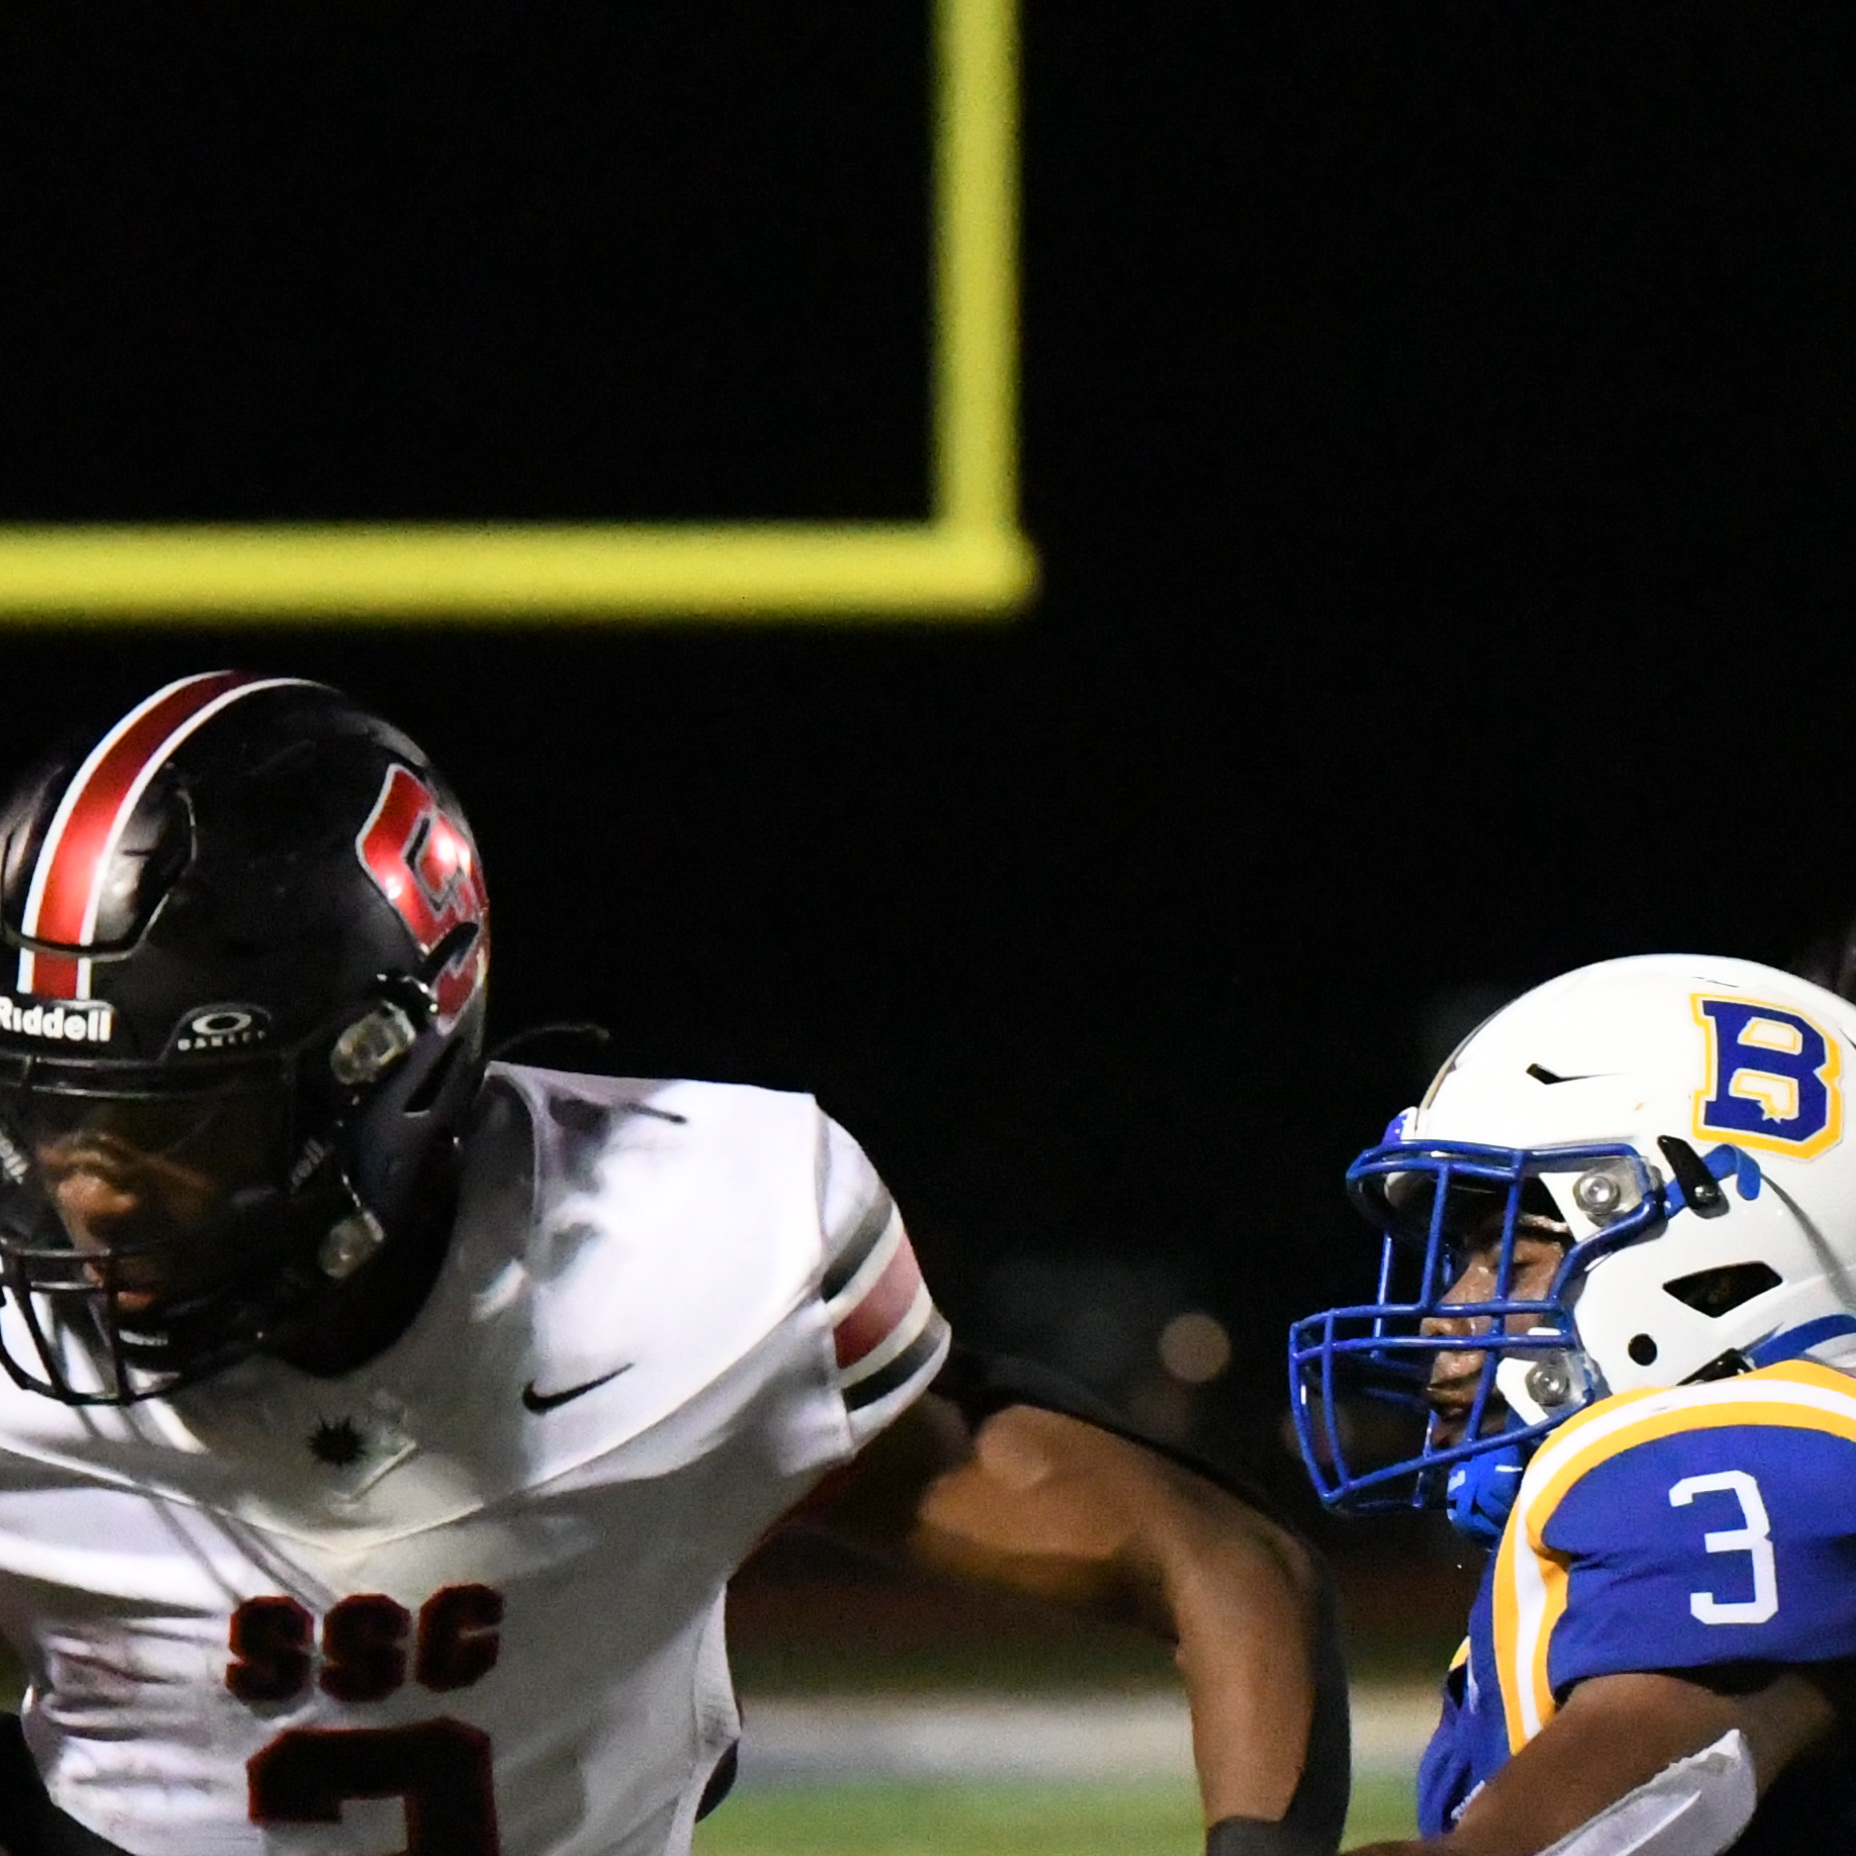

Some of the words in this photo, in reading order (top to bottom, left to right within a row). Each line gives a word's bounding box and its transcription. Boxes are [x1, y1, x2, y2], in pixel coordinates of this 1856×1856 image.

[1688, 992, 1844, 1160] B
[1669, 1469, 1778, 1626] 3
[224, 1582, 505, 1704] SSC
